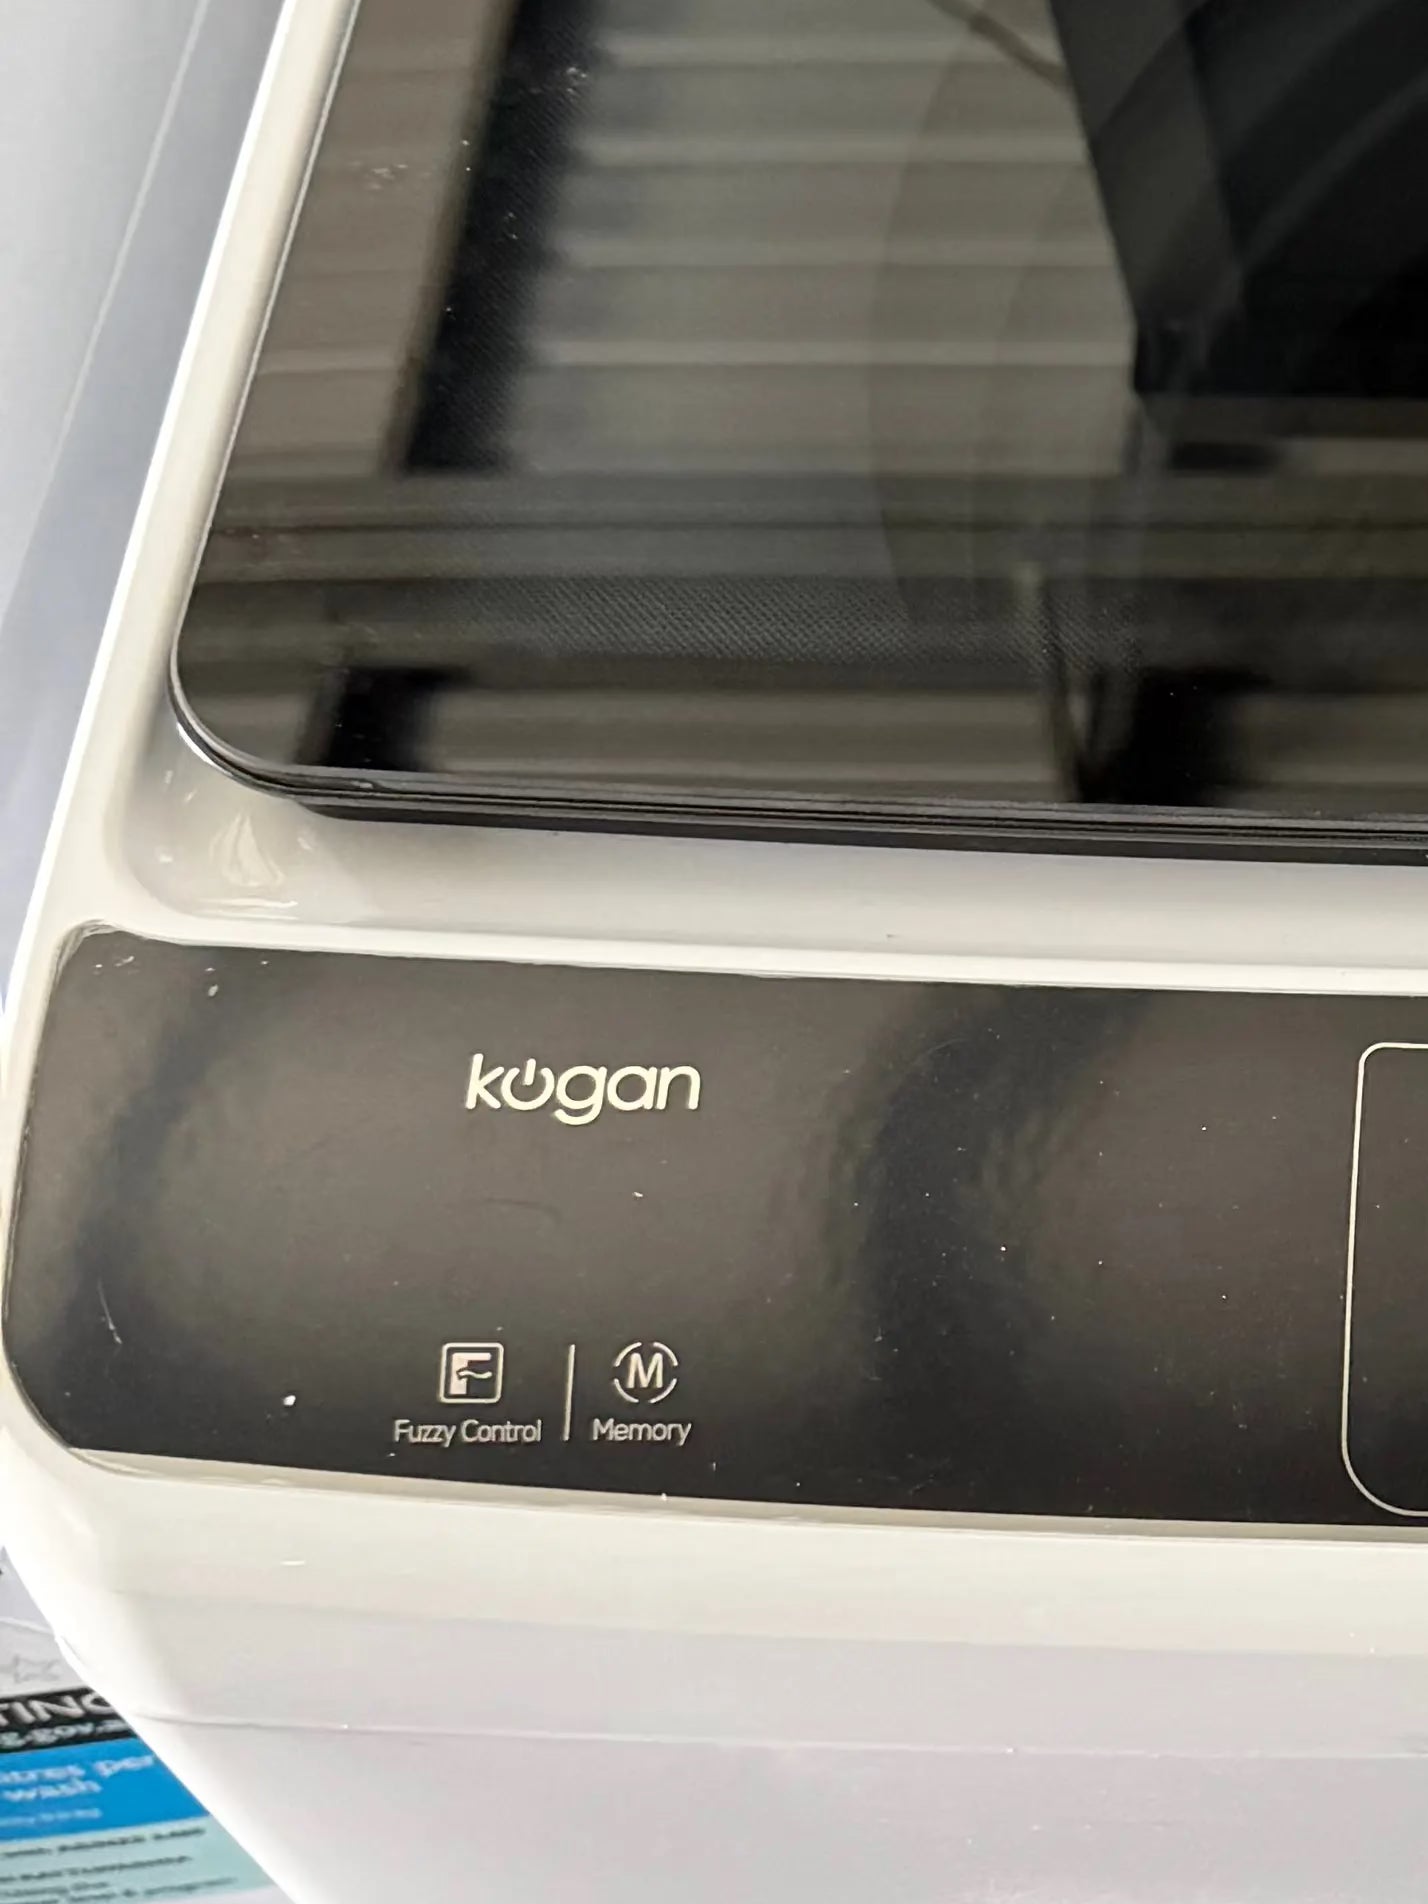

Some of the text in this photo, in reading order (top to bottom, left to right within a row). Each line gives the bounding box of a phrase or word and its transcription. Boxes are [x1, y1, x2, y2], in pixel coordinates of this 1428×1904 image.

[465, 1054, 700, 1125] kogan
[395, 1419, 541, 1447] Fuzzy Control
[593, 1418, 691, 1446] Memory
